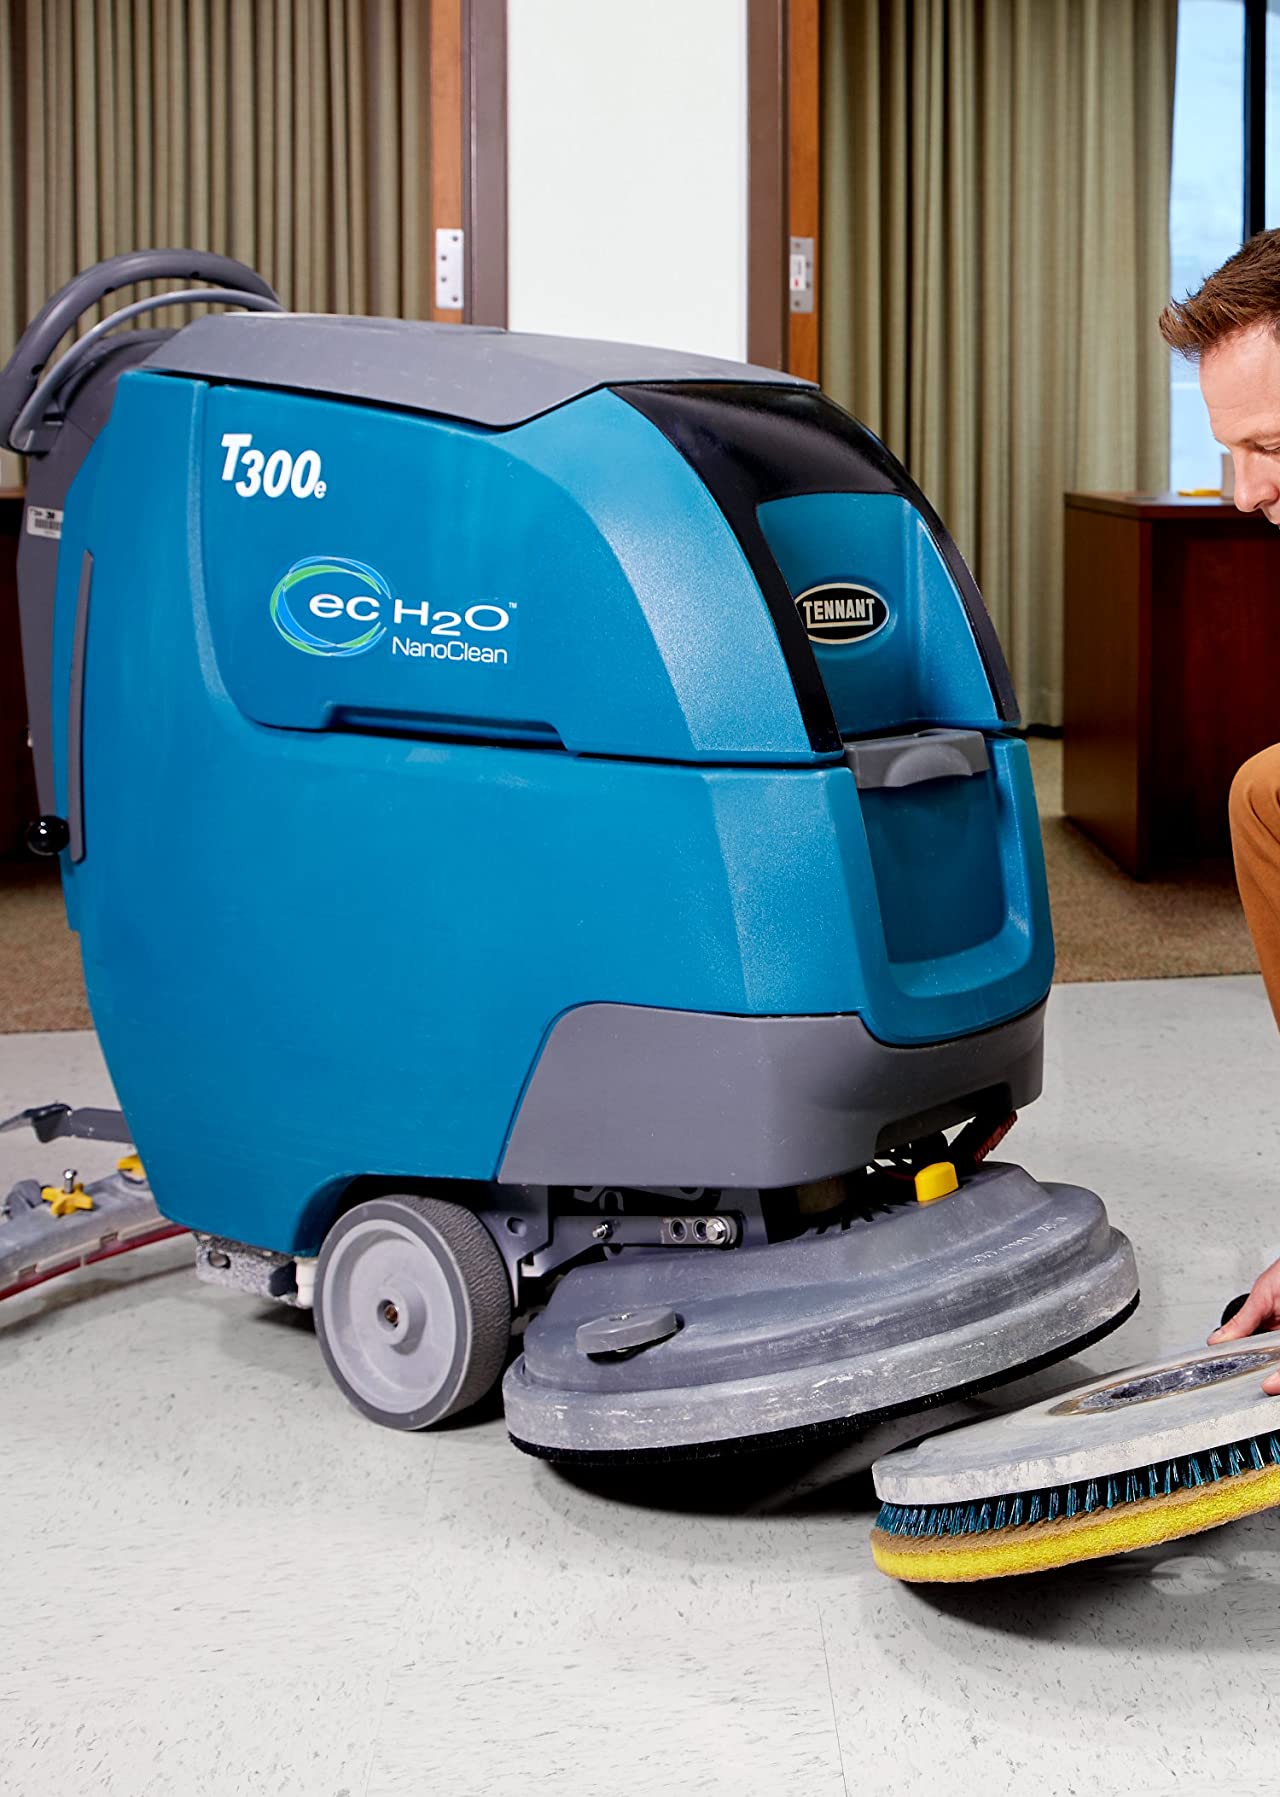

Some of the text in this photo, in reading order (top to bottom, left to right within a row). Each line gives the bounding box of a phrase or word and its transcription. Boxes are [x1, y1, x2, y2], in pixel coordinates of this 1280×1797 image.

[221, 433, 327, 499] T300e
[802, 598, 875, 629] TENNANT
[392, 636, 508, 664] NanoClean
